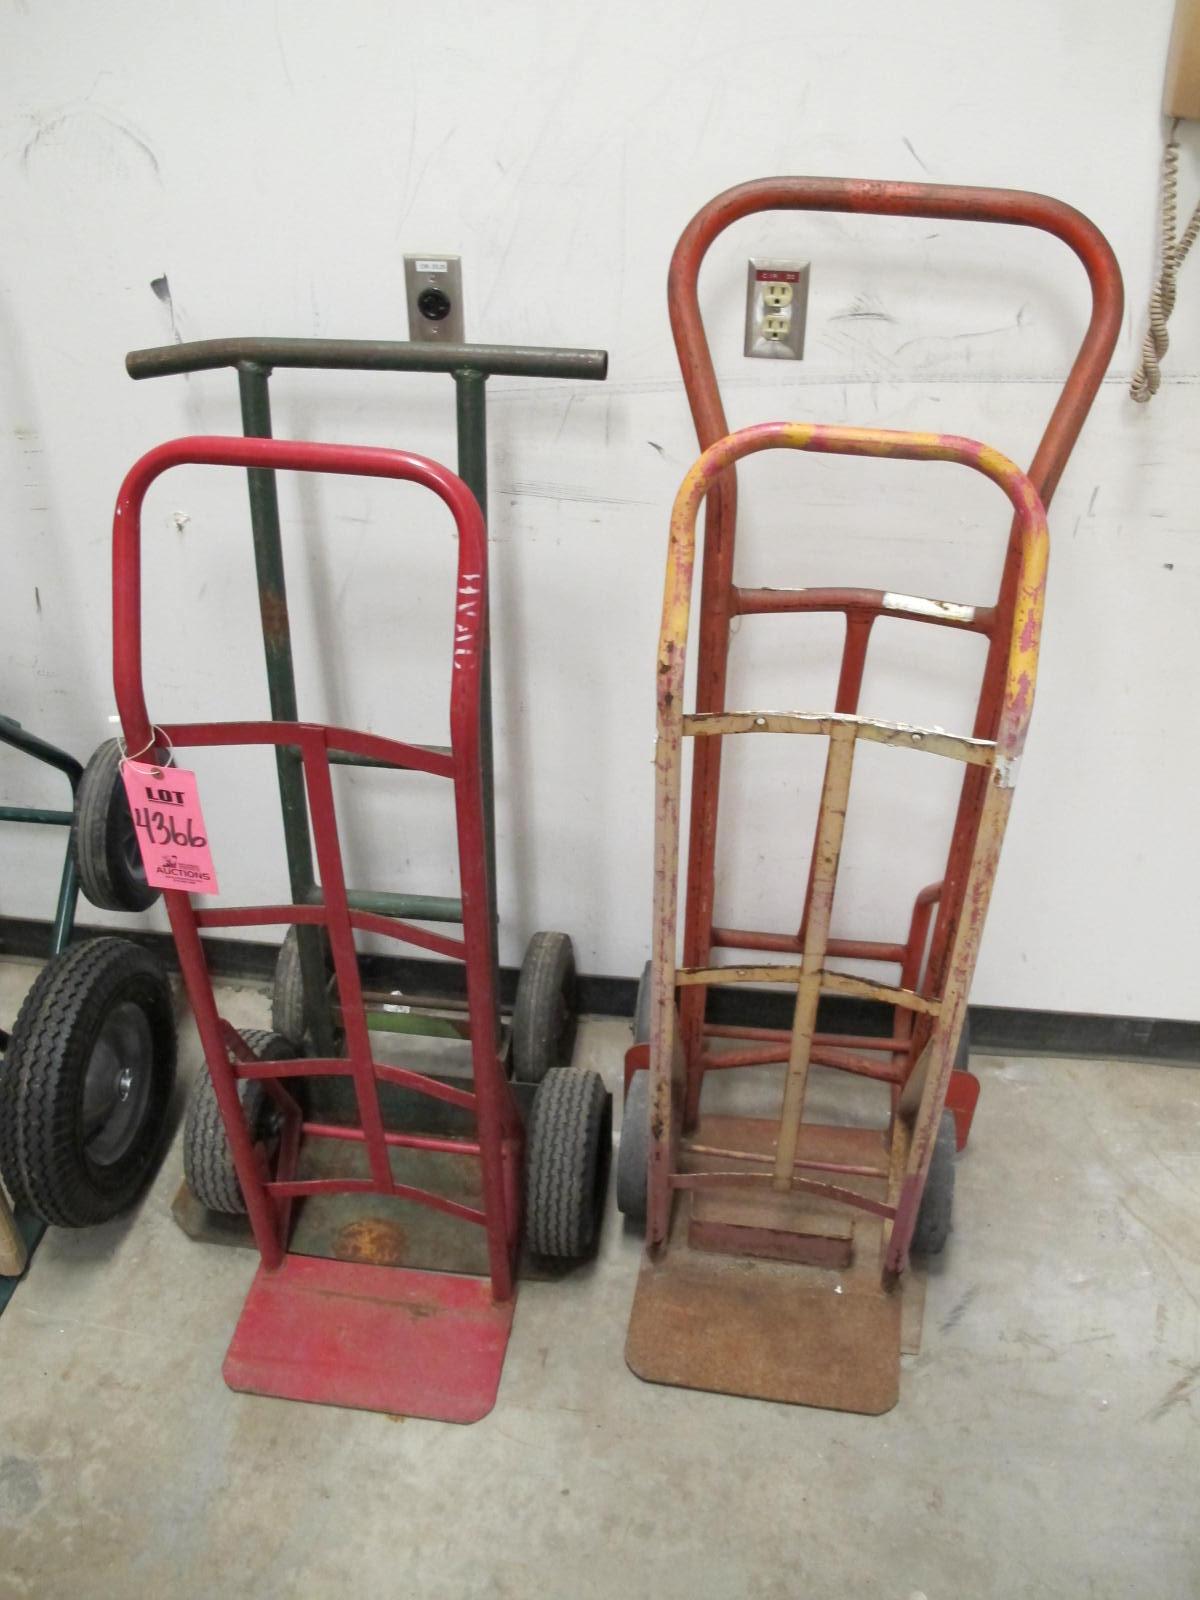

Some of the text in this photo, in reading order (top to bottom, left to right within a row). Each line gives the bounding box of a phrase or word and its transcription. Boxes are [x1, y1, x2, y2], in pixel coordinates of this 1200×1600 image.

[145, 787, 185, 804] LOT
[134, 808, 207, 847] 4366
[156, 867, 211, 881] AUCTIONS
